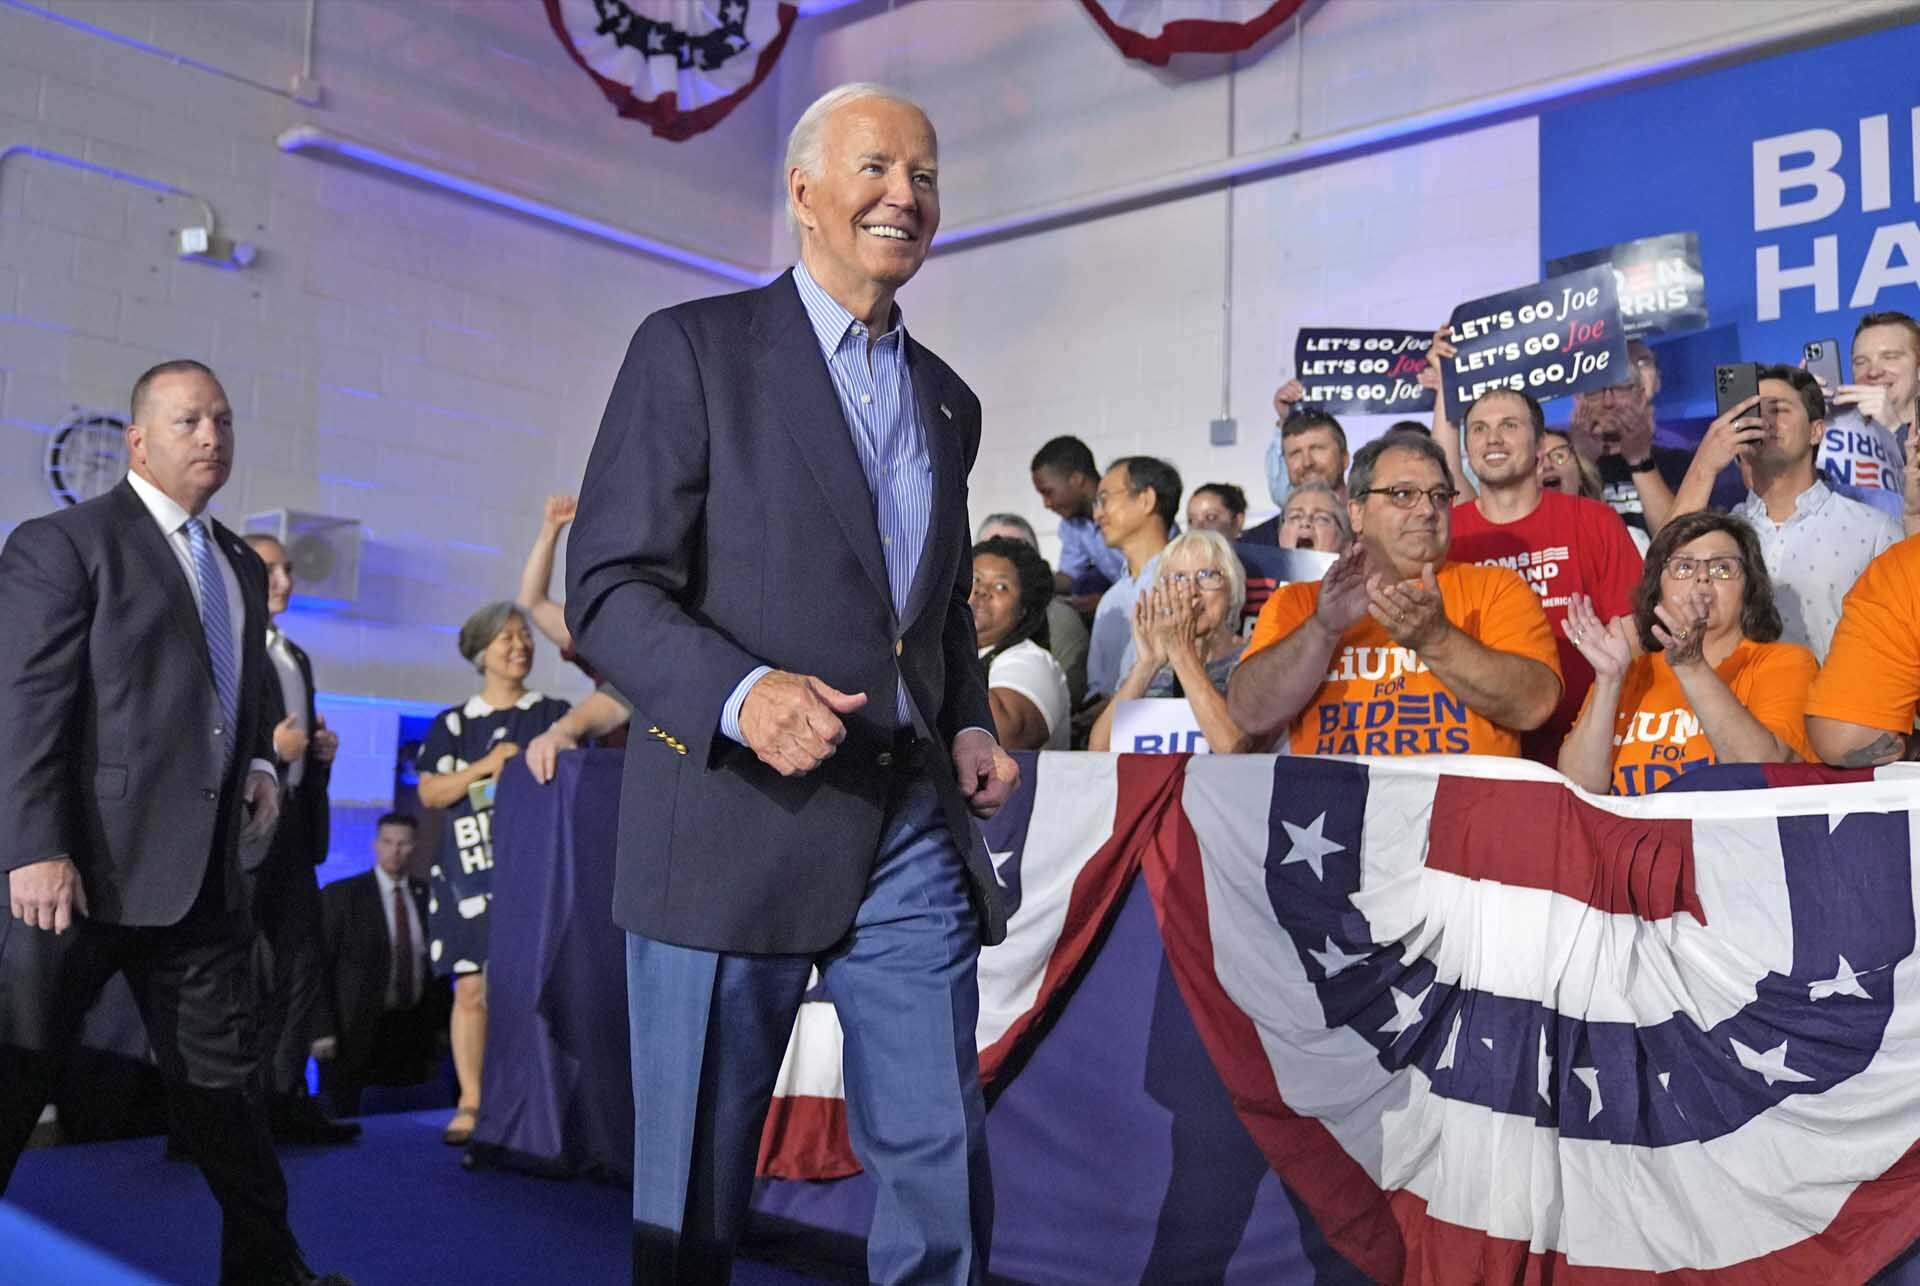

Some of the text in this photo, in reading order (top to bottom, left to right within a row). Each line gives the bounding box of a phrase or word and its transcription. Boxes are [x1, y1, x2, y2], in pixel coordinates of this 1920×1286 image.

[1753, 106, 1920, 232] BI
[1450, 287, 1599, 343] LET'S GO Joe
[1306, 335, 1433, 354] LET'S GO Joe
[1455, 320, 1605, 374] LET'S GO Joe
[1302, 355, 1428, 378] LET'S GO Joe
[1458, 351, 1610, 402] LET'S GO Joe
[1303, 378, 1424, 405] LET'S GO Joe
[1374, 676, 1406, 698] FOR
[1318, 691, 1467, 736] BIDEN
[1315, 727, 1470, 755] HARRIS
